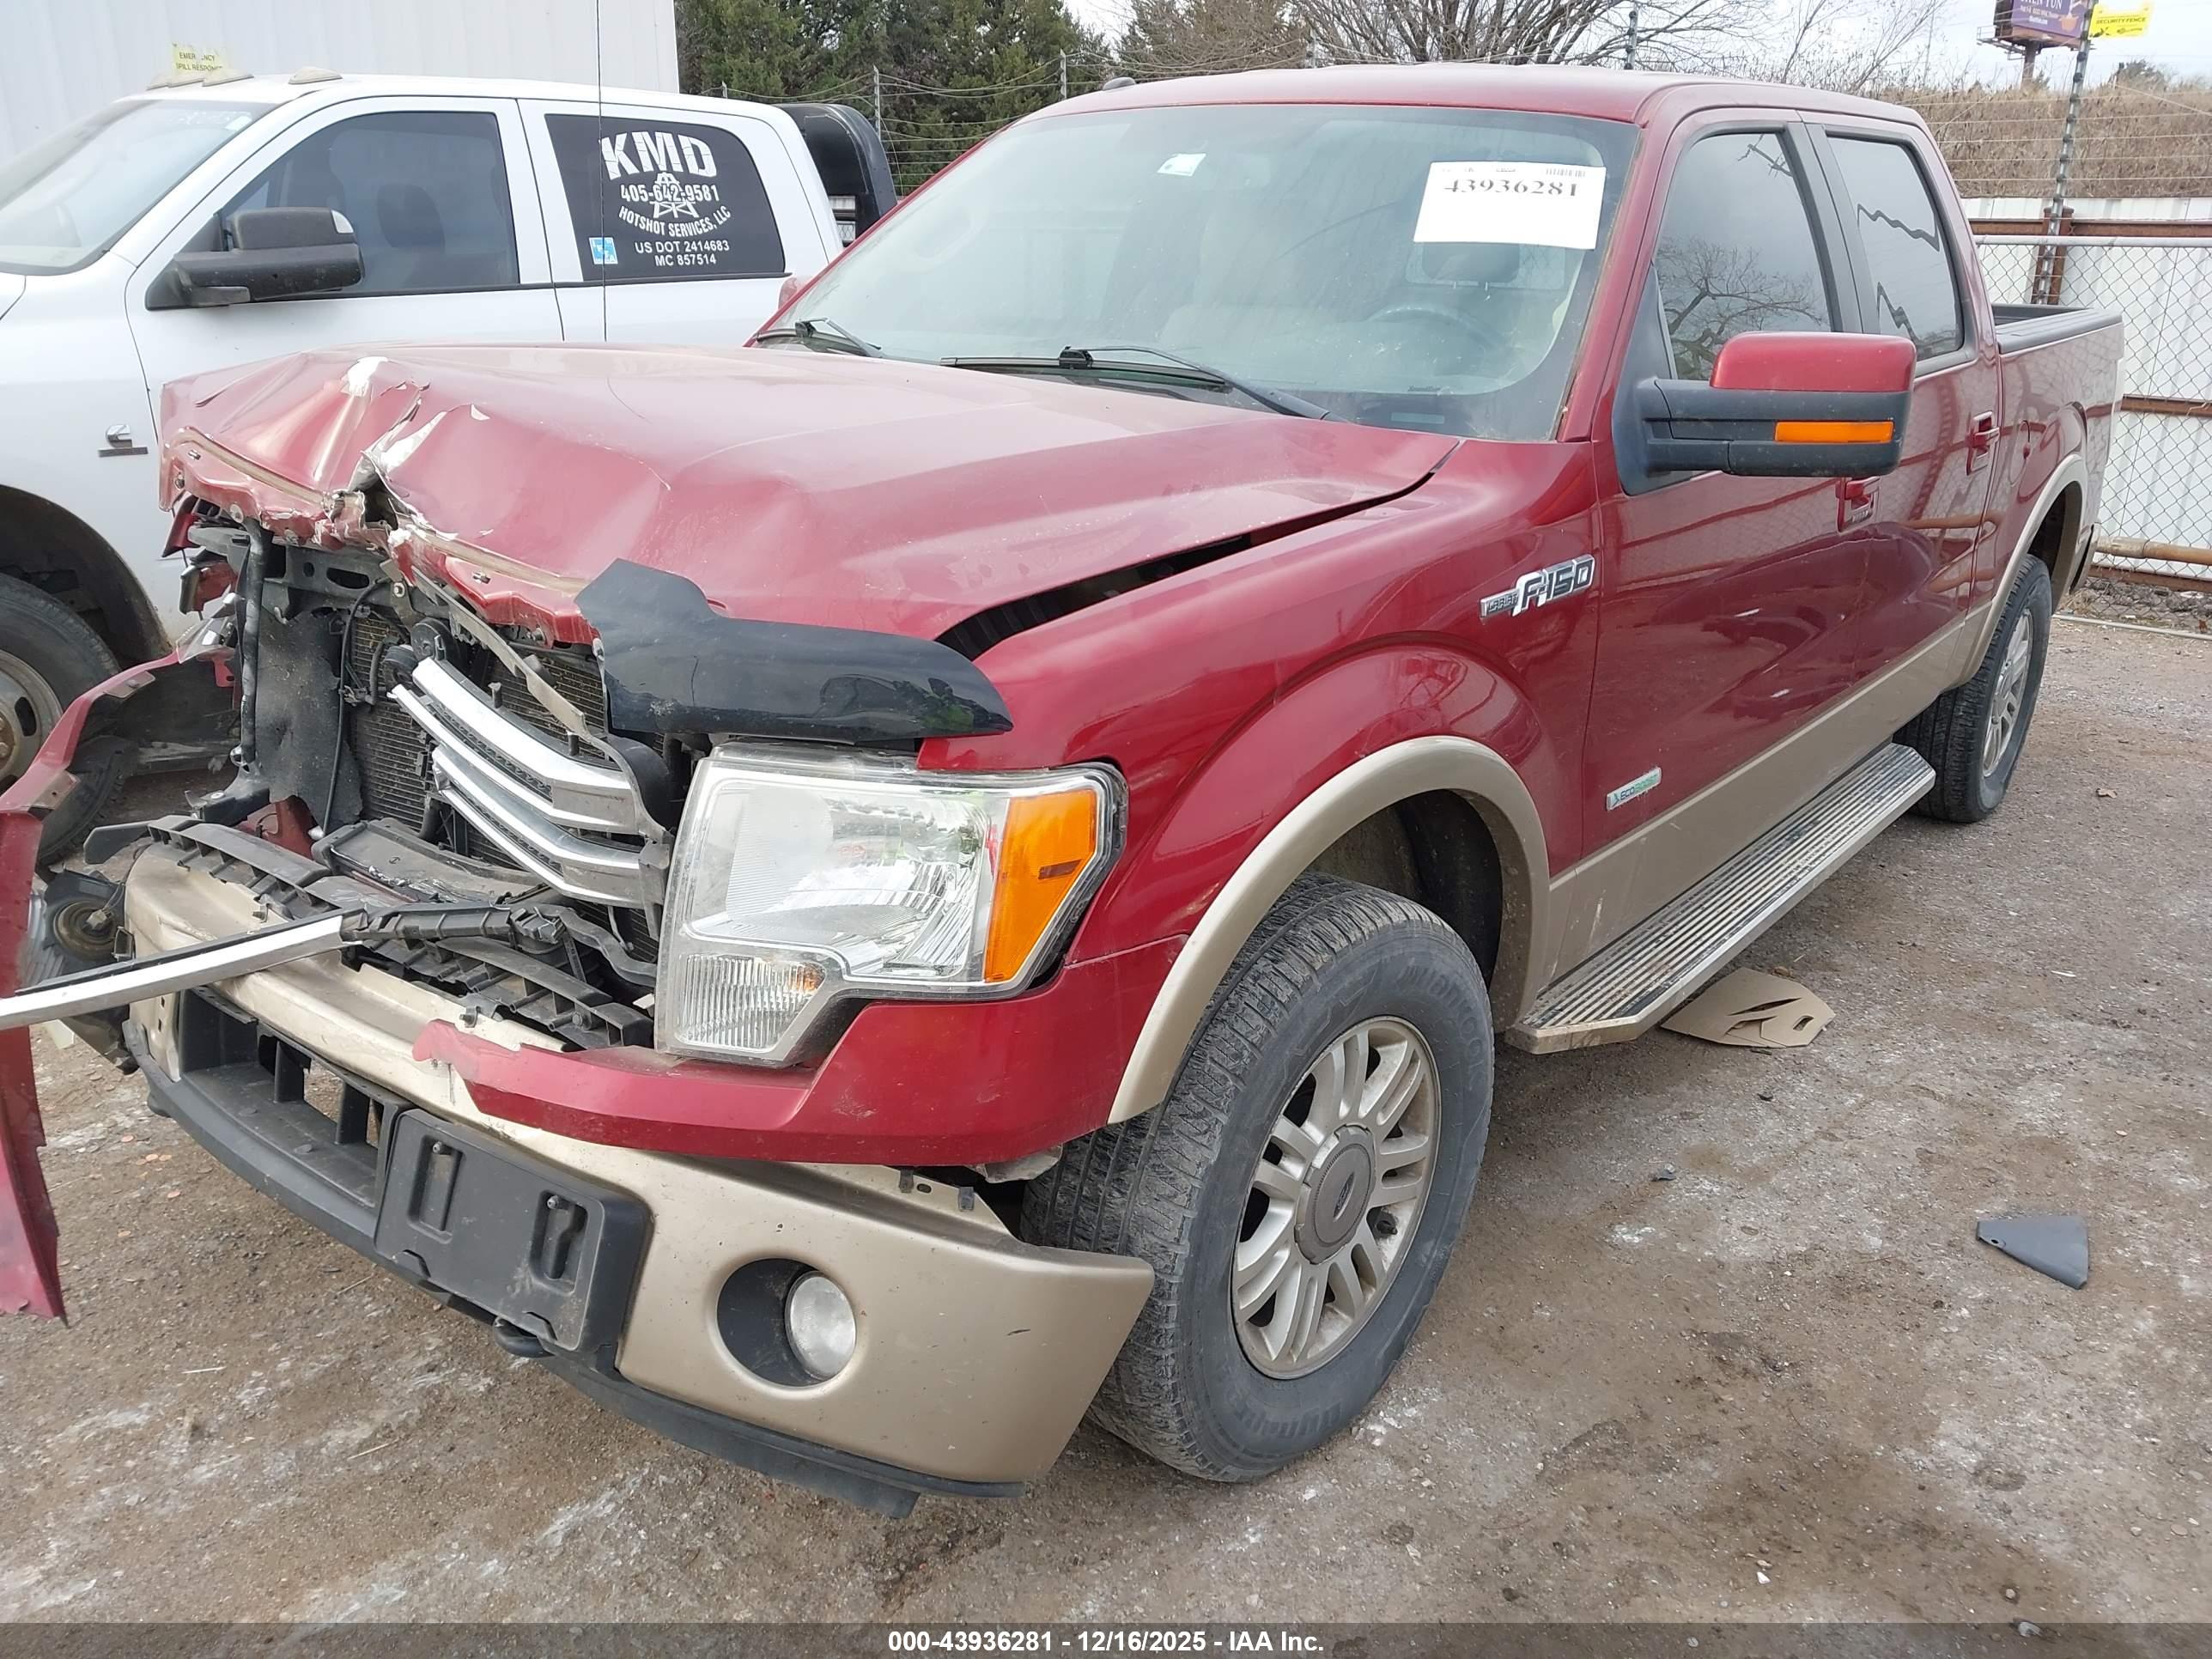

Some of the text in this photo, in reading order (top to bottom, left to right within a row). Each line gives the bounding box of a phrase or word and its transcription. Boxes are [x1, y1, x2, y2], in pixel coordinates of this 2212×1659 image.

[179, 52, 216, 62] EMERNCY
[600, 131, 717, 181] KMD
[620, 184, 720, 202] 405-642-9581
[1443, 178, 1578, 198] 43936281
[618, 205, 732, 237] HOTSHOT SERVICES, LLC
[635, 240, 731, 254] US DOT 2414683
[654, 253, 717, 267] MC 857514
